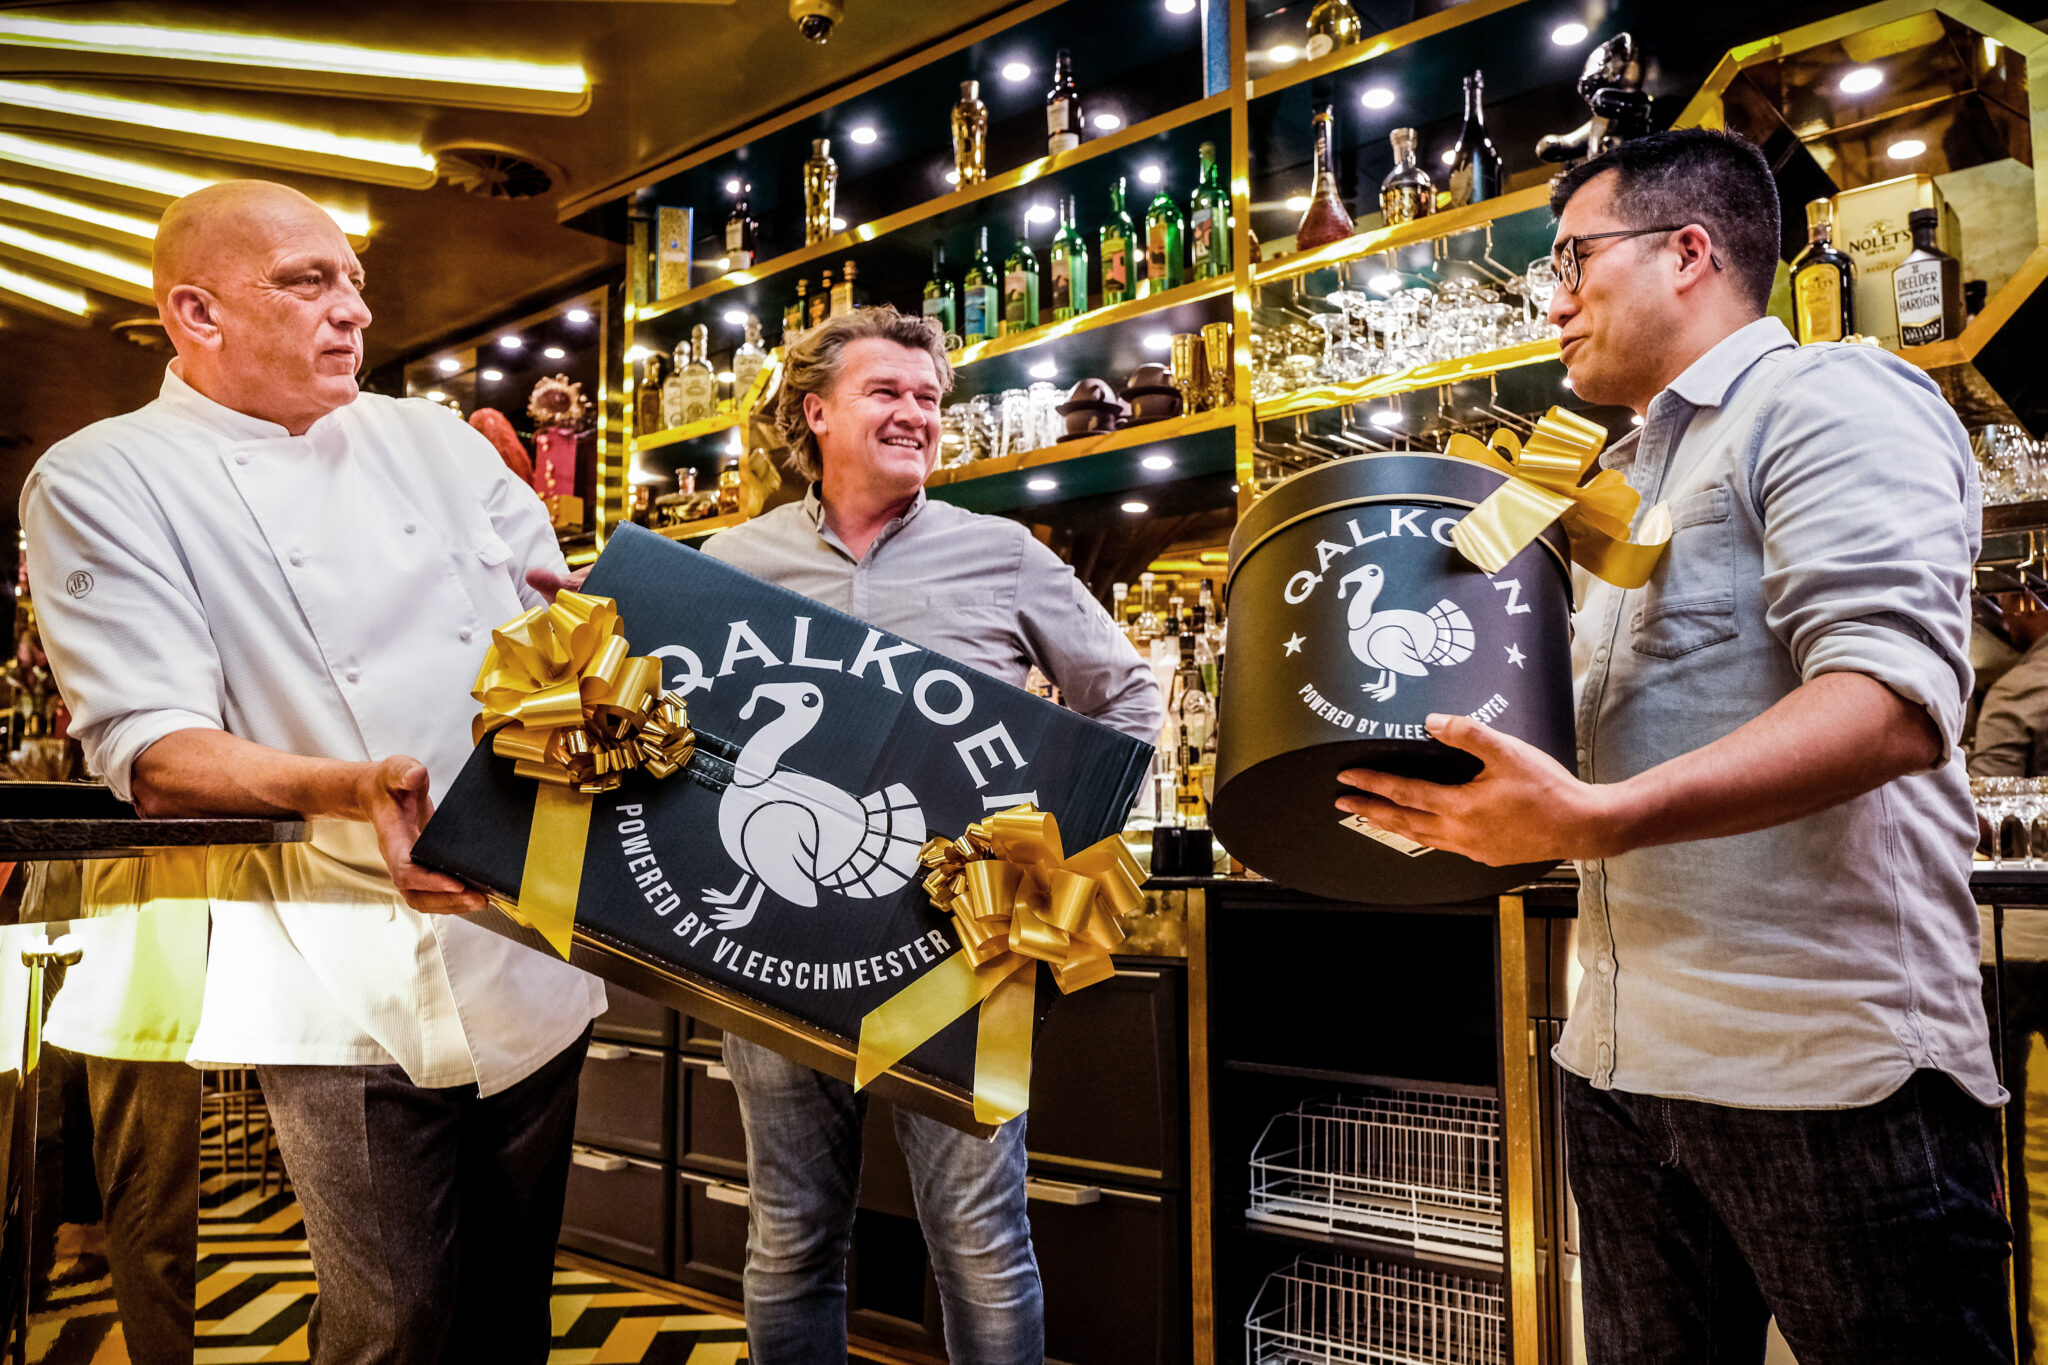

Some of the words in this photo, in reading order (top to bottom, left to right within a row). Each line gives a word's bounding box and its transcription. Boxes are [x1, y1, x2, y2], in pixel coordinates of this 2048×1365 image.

[1897, 270, 1938, 291] DEELDER
[1899, 291, 1940, 313] HARDGIN
[1284, 505, 1532, 616] QALKON
[1298, 682, 1356, 729] POWERED
[1356, 717, 1380, 736] BY
[1384, 693, 1511, 740] VLEEESTER
[616, 803, 681, 919] POWERED
[672, 911, 714, 948] BY
[712, 928, 952, 990] VLEESCHMEESTER
